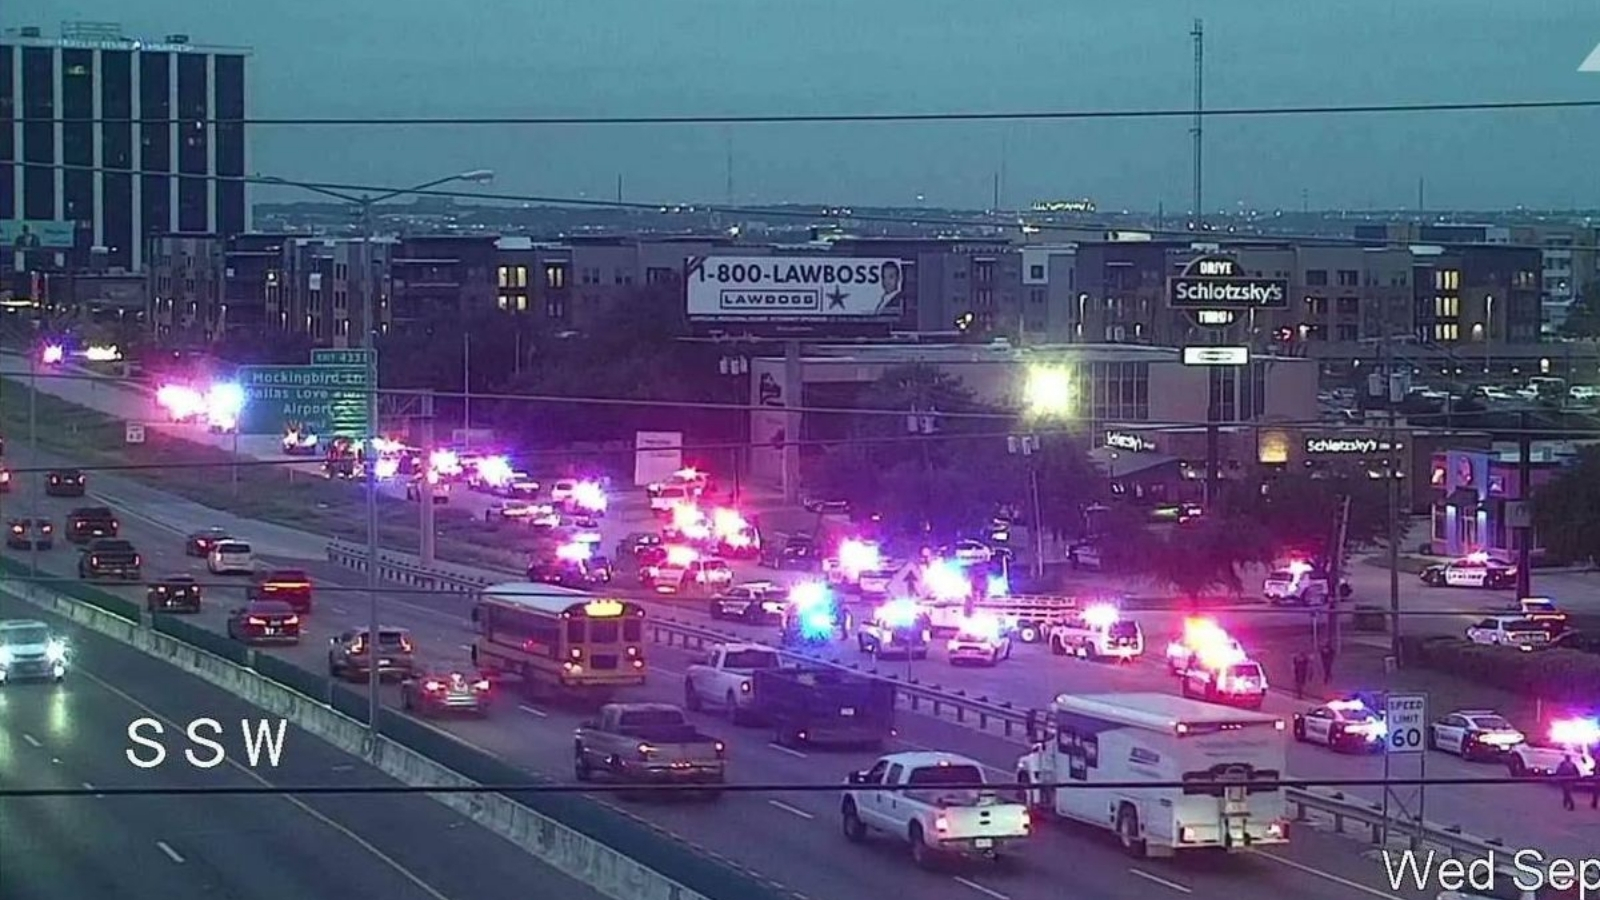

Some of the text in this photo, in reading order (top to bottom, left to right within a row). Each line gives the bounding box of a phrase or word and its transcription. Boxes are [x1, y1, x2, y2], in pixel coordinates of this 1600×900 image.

[699, 263, 880, 284] 1-800-LAWBOSS
[1199, 261, 1233, 275] DRIVE
[1176, 281, 1283, 304] Schlotzsky's
[252, 370, 340, 384] Mockingbird
[296, 387, 329, 400] Love
[282, 402, 334, 417] Airport
[1389, 700, 1423, 710] SPEED
[1392, 713, 1419, 724] LIMIT
[1391, 727, 1421, 748] 60
